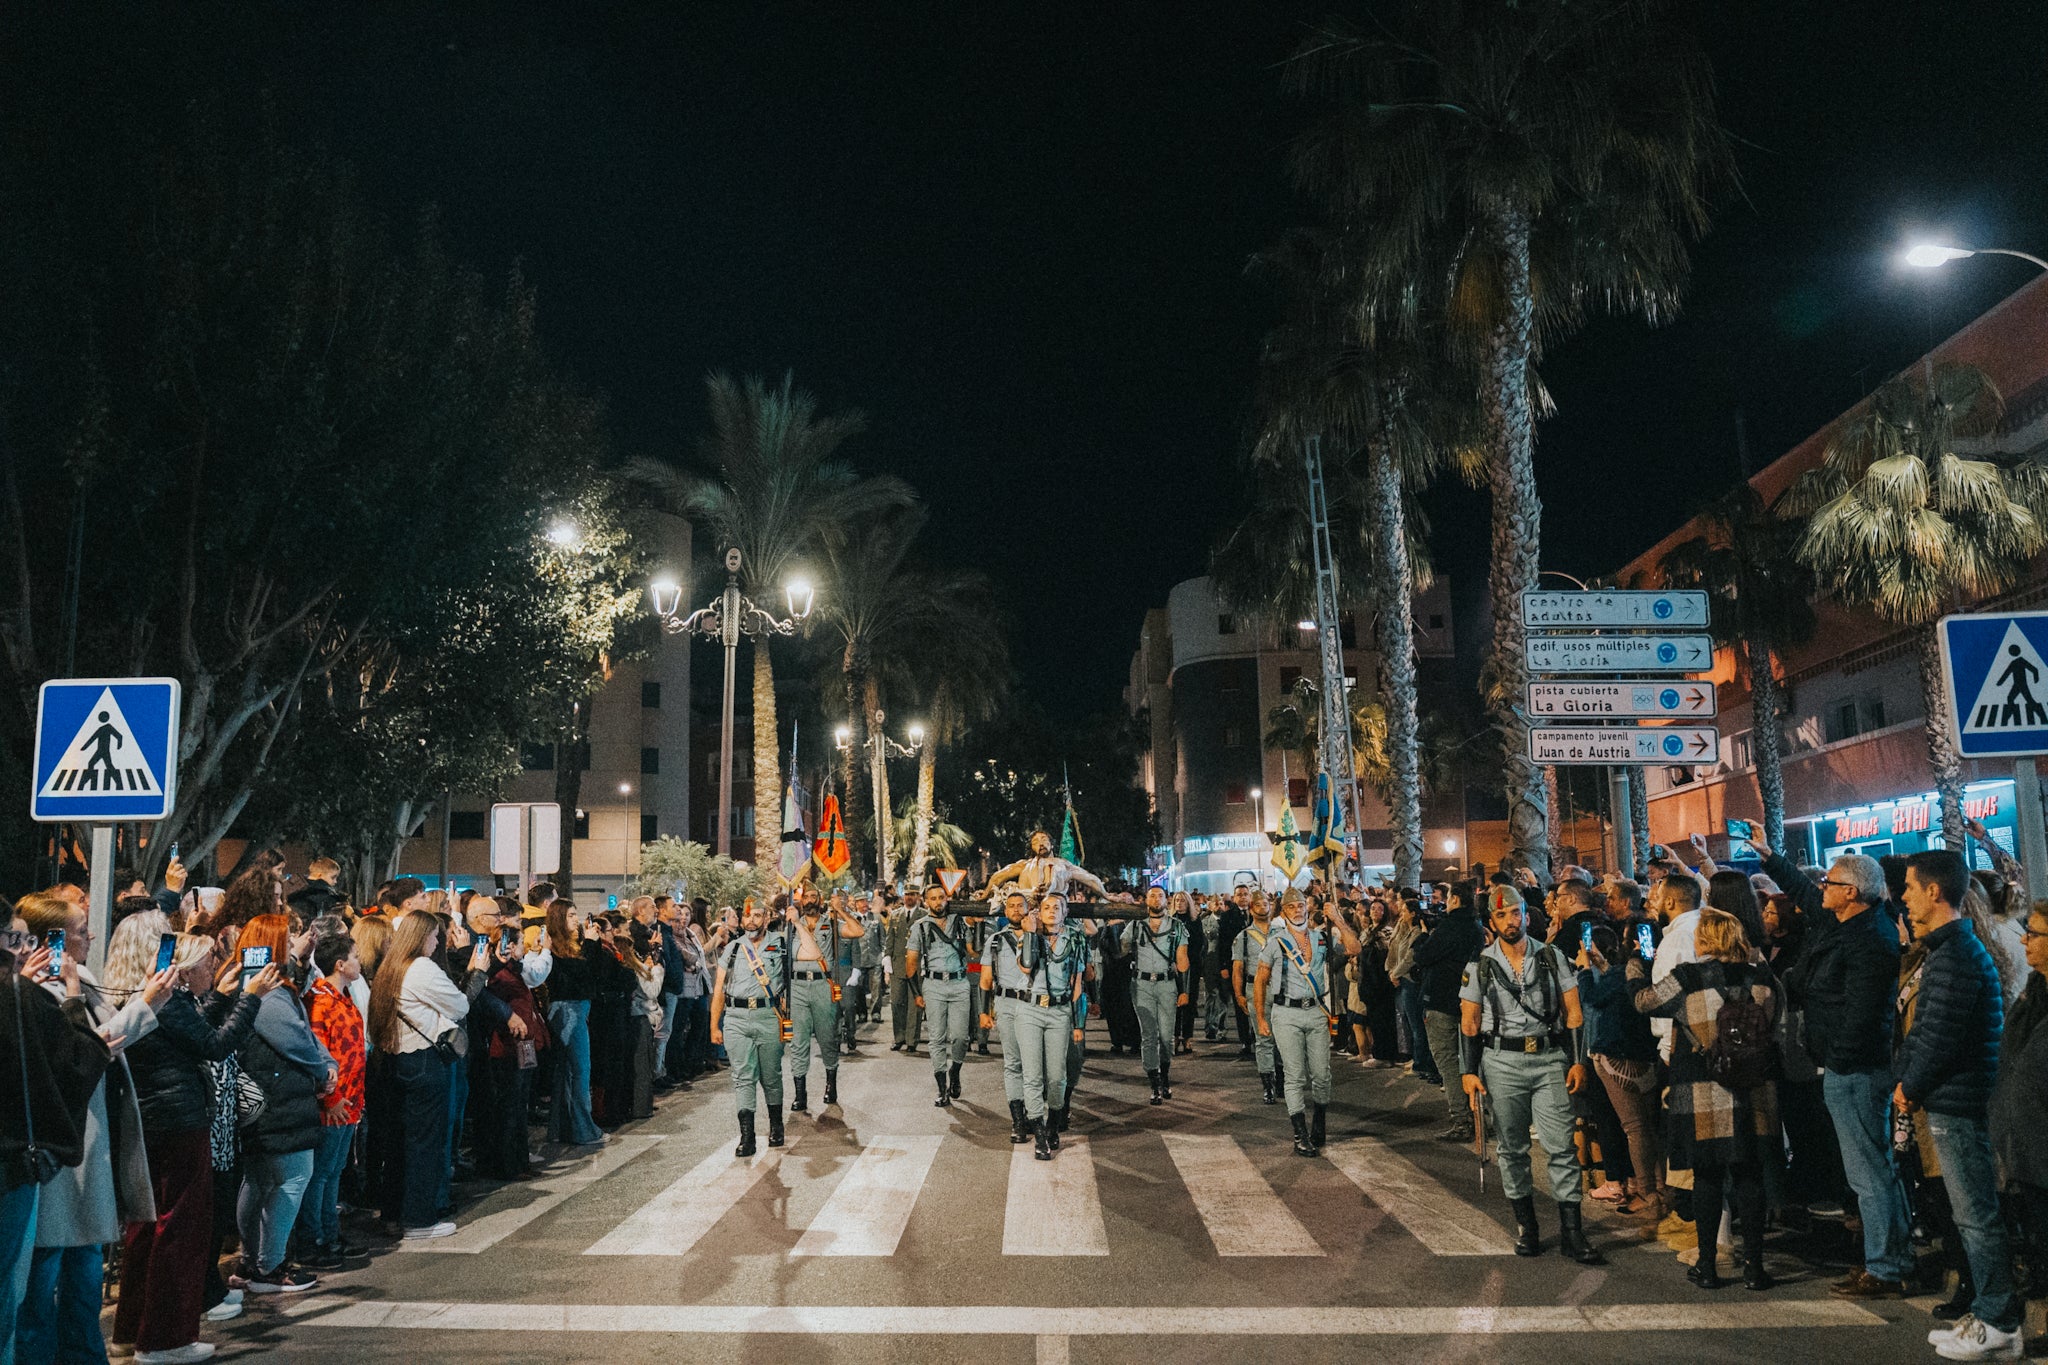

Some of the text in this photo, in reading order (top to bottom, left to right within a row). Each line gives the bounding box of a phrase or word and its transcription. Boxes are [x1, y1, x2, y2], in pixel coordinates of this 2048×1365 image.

[1533, 640, 1651, 653] edif. usos múltiples
[1535, 686, 1619, 696] pista cubierta
[1535, 699, 1613, 712] La Gloria
[1537, 731, 1629, 743] campamento juvenil
[1538, 745, 1631, 758] Juan de Austria
[1891, 803, 1930, 835] SEVEN
